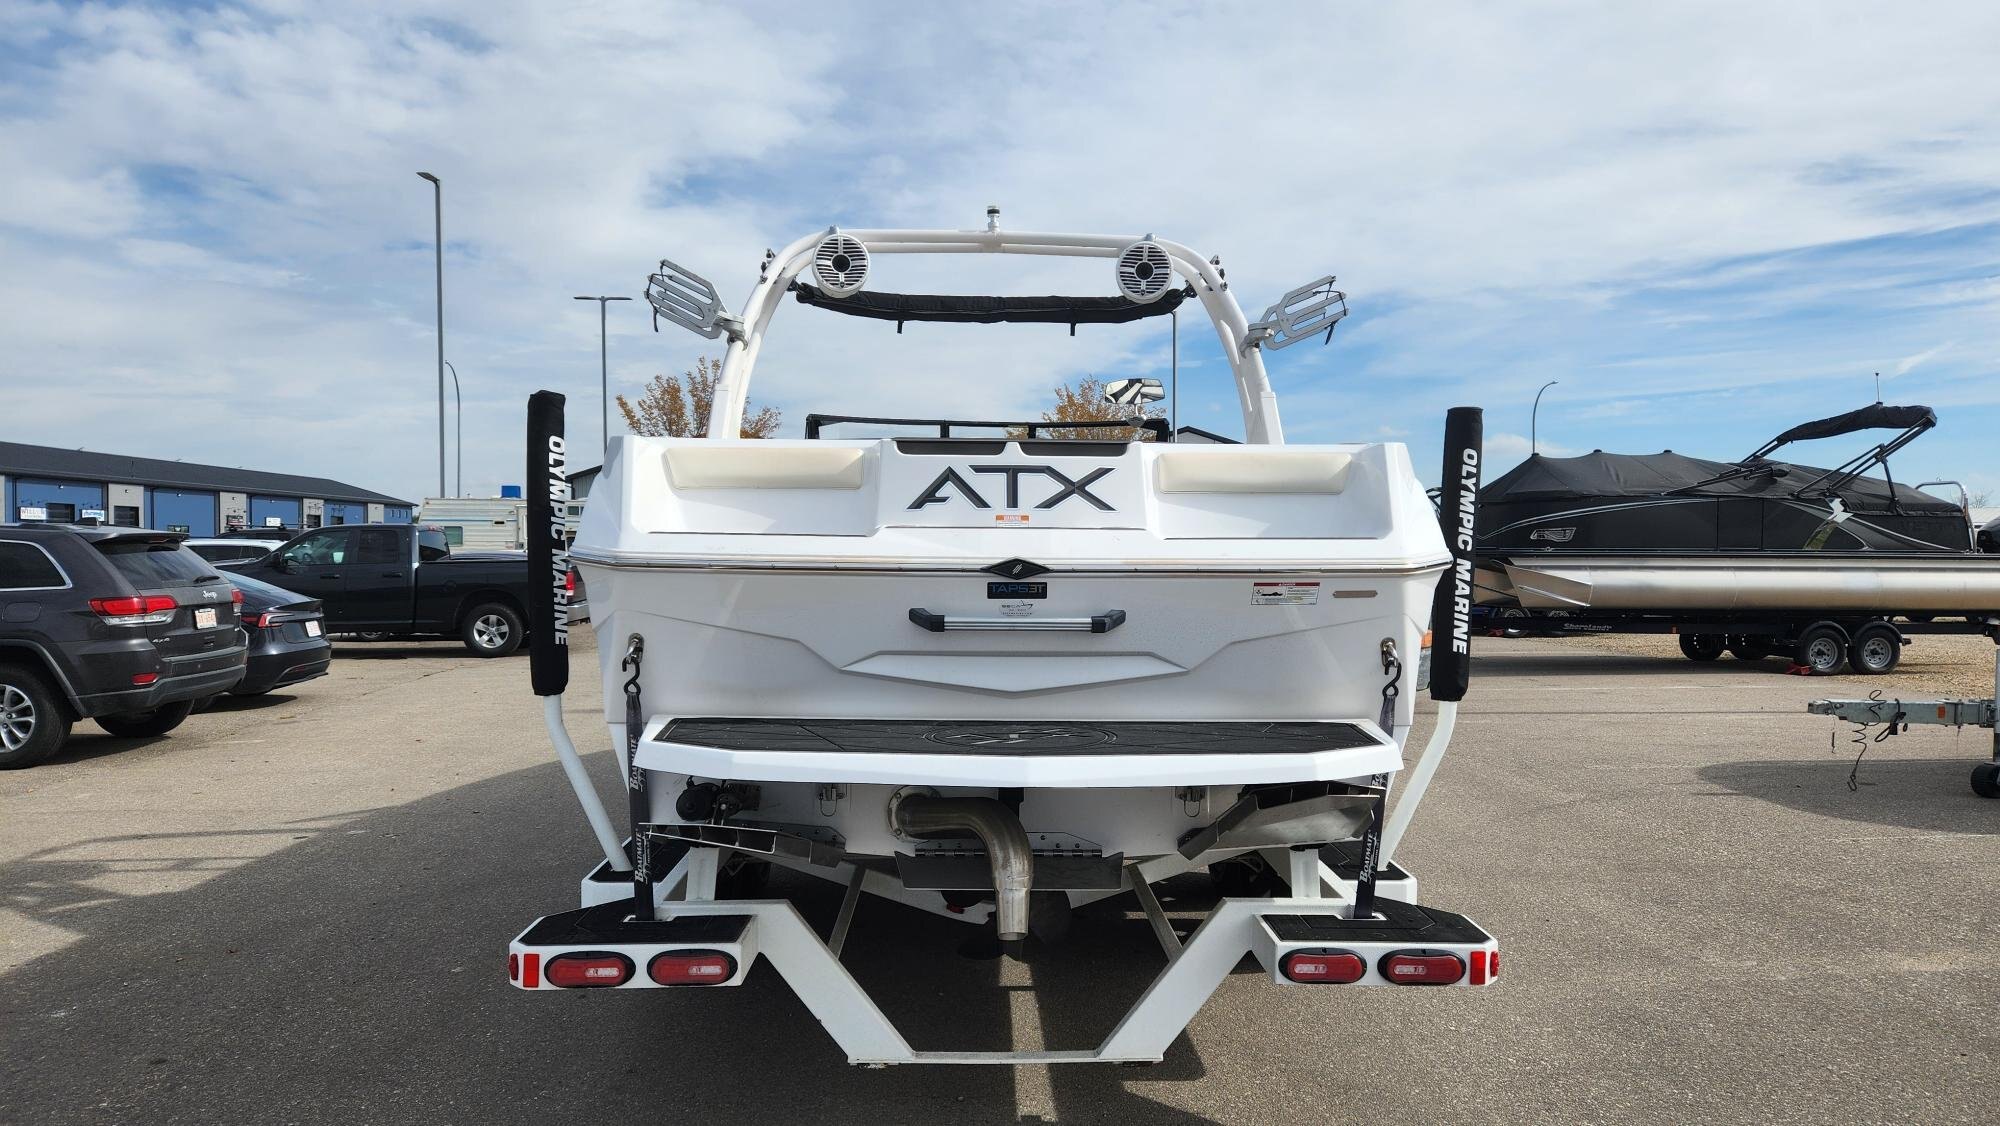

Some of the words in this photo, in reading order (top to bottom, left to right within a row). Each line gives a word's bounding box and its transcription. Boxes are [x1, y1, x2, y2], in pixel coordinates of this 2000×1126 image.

[549, 435, 567, 541] OLYMPIC
[906, 465, 1117, 511] ATX
[1457, 448, 1478, 552] OLYMPIC
[203, 590, 217, 599] Jeep
[552, 548, 569, 647] MARINE
[1452, 557, 1472, 655] MARINE
